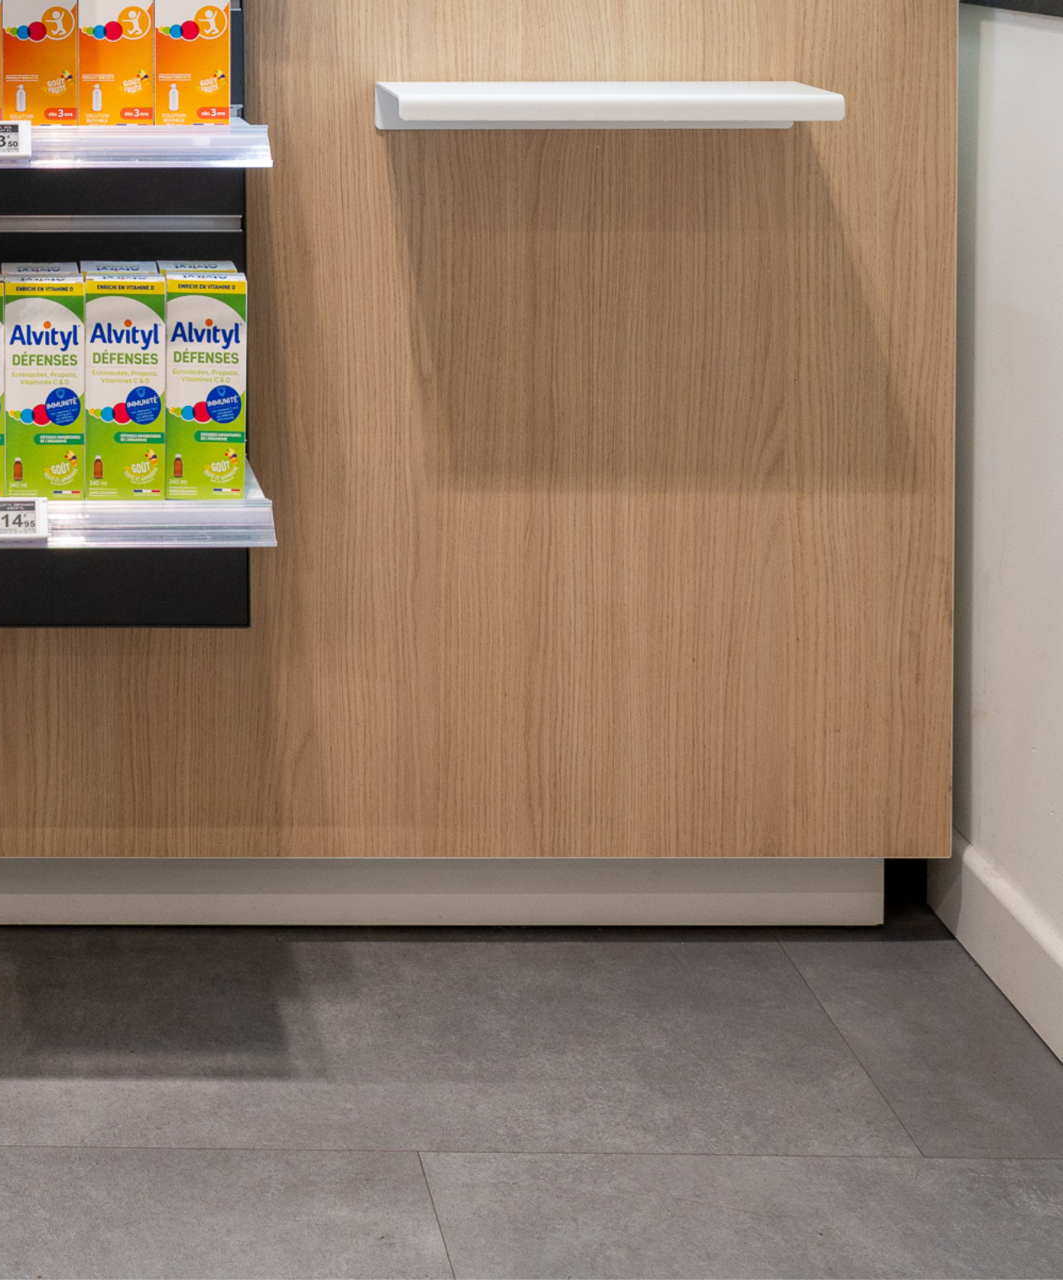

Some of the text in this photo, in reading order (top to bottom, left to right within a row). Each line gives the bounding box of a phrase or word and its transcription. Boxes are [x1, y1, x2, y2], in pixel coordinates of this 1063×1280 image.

[9, 321, 80, 352] Alvityl
[89, 319, 160, 350] Alvityl
[170, 318, 241, 350] Alvityl
[12, 351, 78, 367] DÉFENSES
[92, 349, 159, 366] DÉFENSES
[173, 348, 240, 365] DÉFENSES
[1, 513, 24, 528] 14
